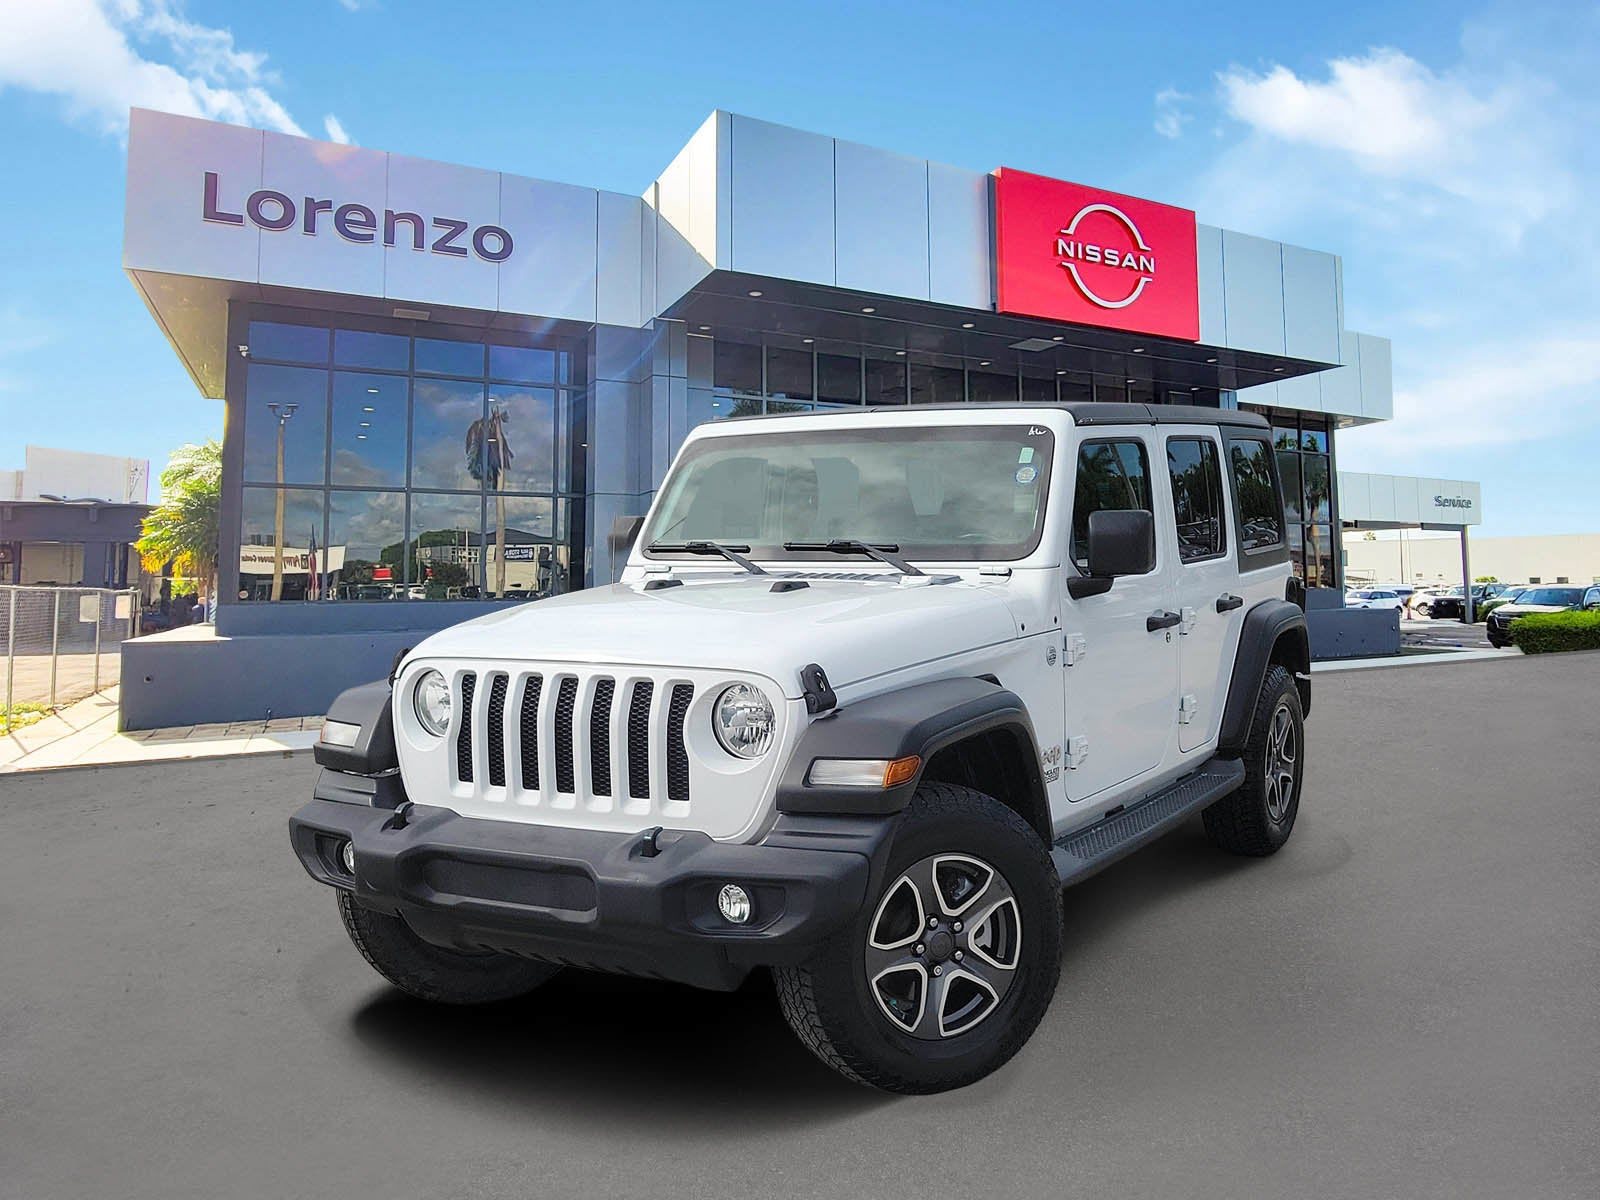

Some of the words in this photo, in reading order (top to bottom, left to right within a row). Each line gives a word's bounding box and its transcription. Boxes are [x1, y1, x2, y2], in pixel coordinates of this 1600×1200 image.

[203, 171, 514, 263] Lorenzo
[1057, 239, 1155, 273] NISSAN
[1433, 495, 1472, 509] Service
